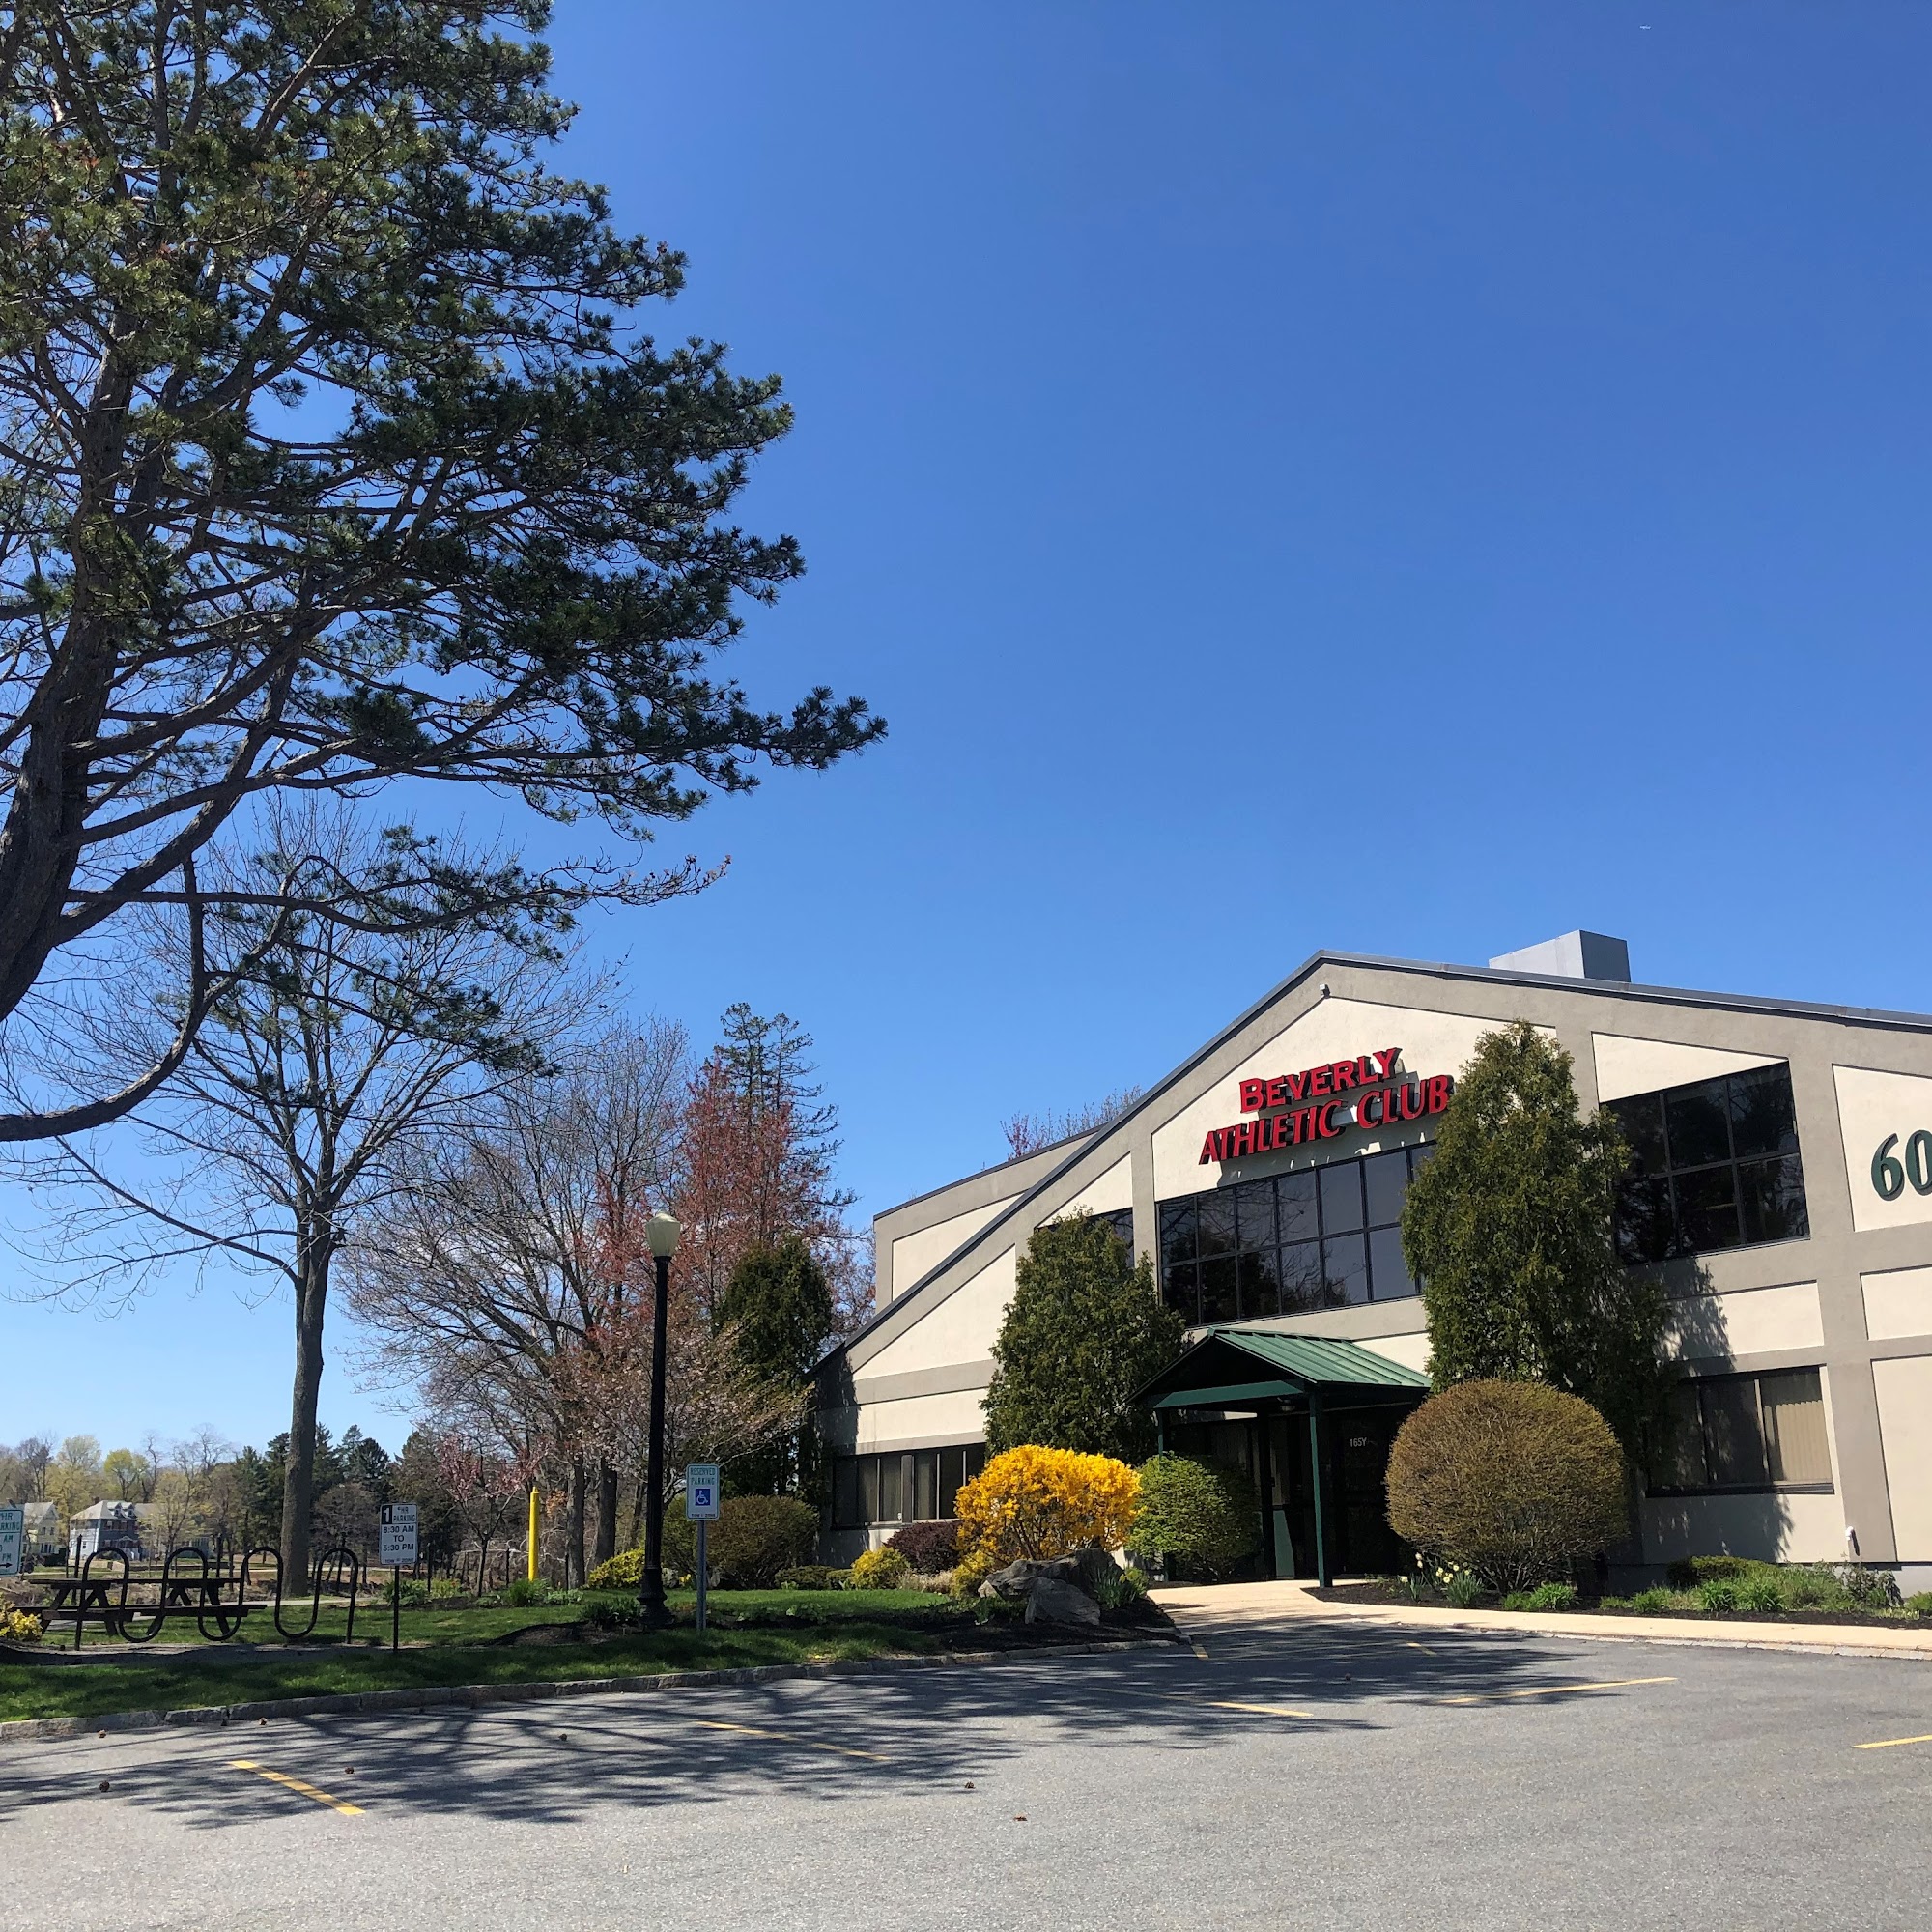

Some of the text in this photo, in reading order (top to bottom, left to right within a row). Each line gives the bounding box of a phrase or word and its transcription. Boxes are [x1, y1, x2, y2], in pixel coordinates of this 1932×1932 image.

[1239, 1047, 1403, 1114] BEVERLY
[1198, 1074, 1454, 1166] ATHLETIC CLUB
[690, 1467, 716, 1476] RESERVED
[690, 1477, 716, 1486] PARKING
[383, 1507, 390, 1523] 1
[393, 1514, 415, 1522] PARKING
[0, 1521, 20, 1531] RKING
[383, 1525, 400, 1534] 8:30
[4, 1534, 14, 1543] AM
[393, 1534, 405, 1543] TO
[383, 1544, 400, 1552] 5:30
[2, 1552, 12, 1562] PM
